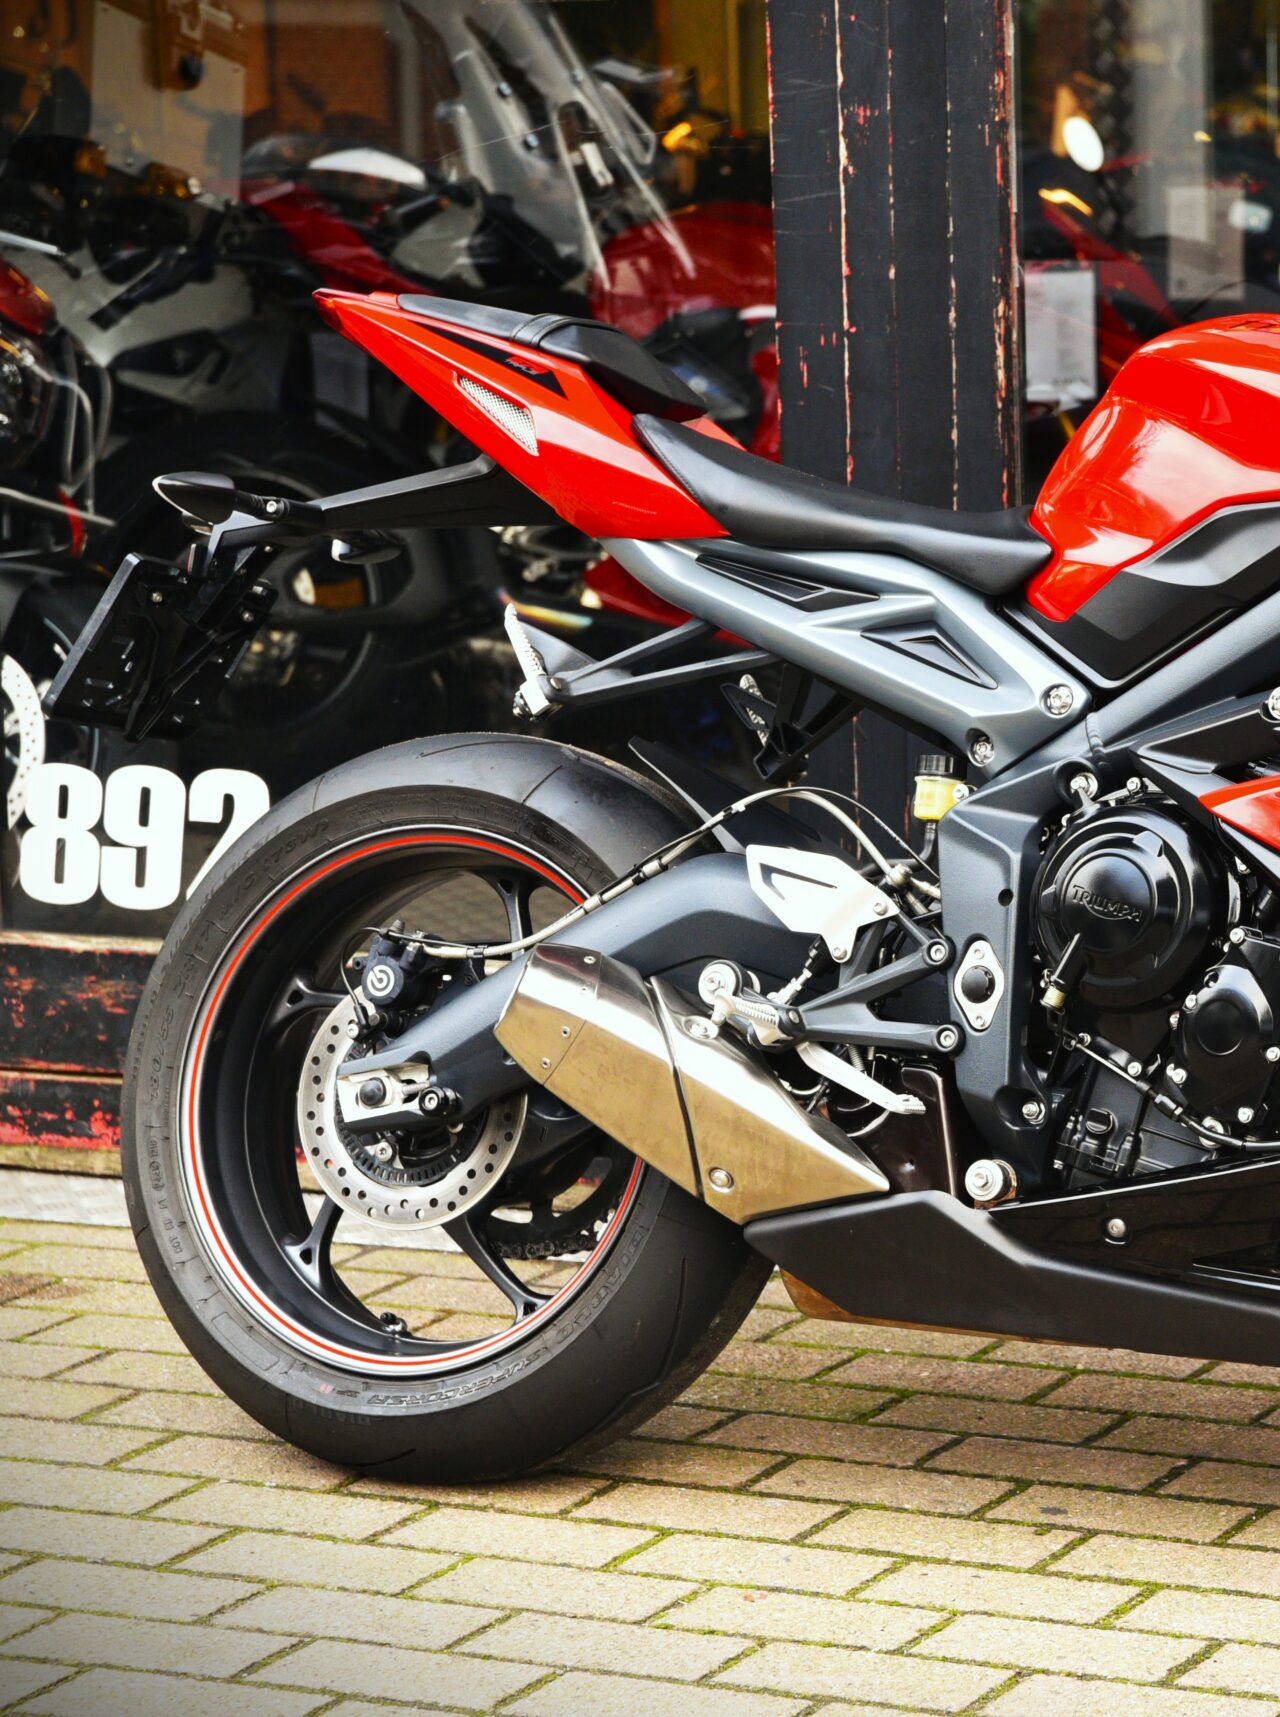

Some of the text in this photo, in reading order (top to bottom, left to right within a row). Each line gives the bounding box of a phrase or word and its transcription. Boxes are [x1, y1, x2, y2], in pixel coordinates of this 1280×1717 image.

[19, 762, 270, 911] 892
[1073, 885, 1142, 922] TRIUMPH
[550, 1227, 644, 1347] DIABLO
[368, 1344, 547, 1405] SUPERCORSA
